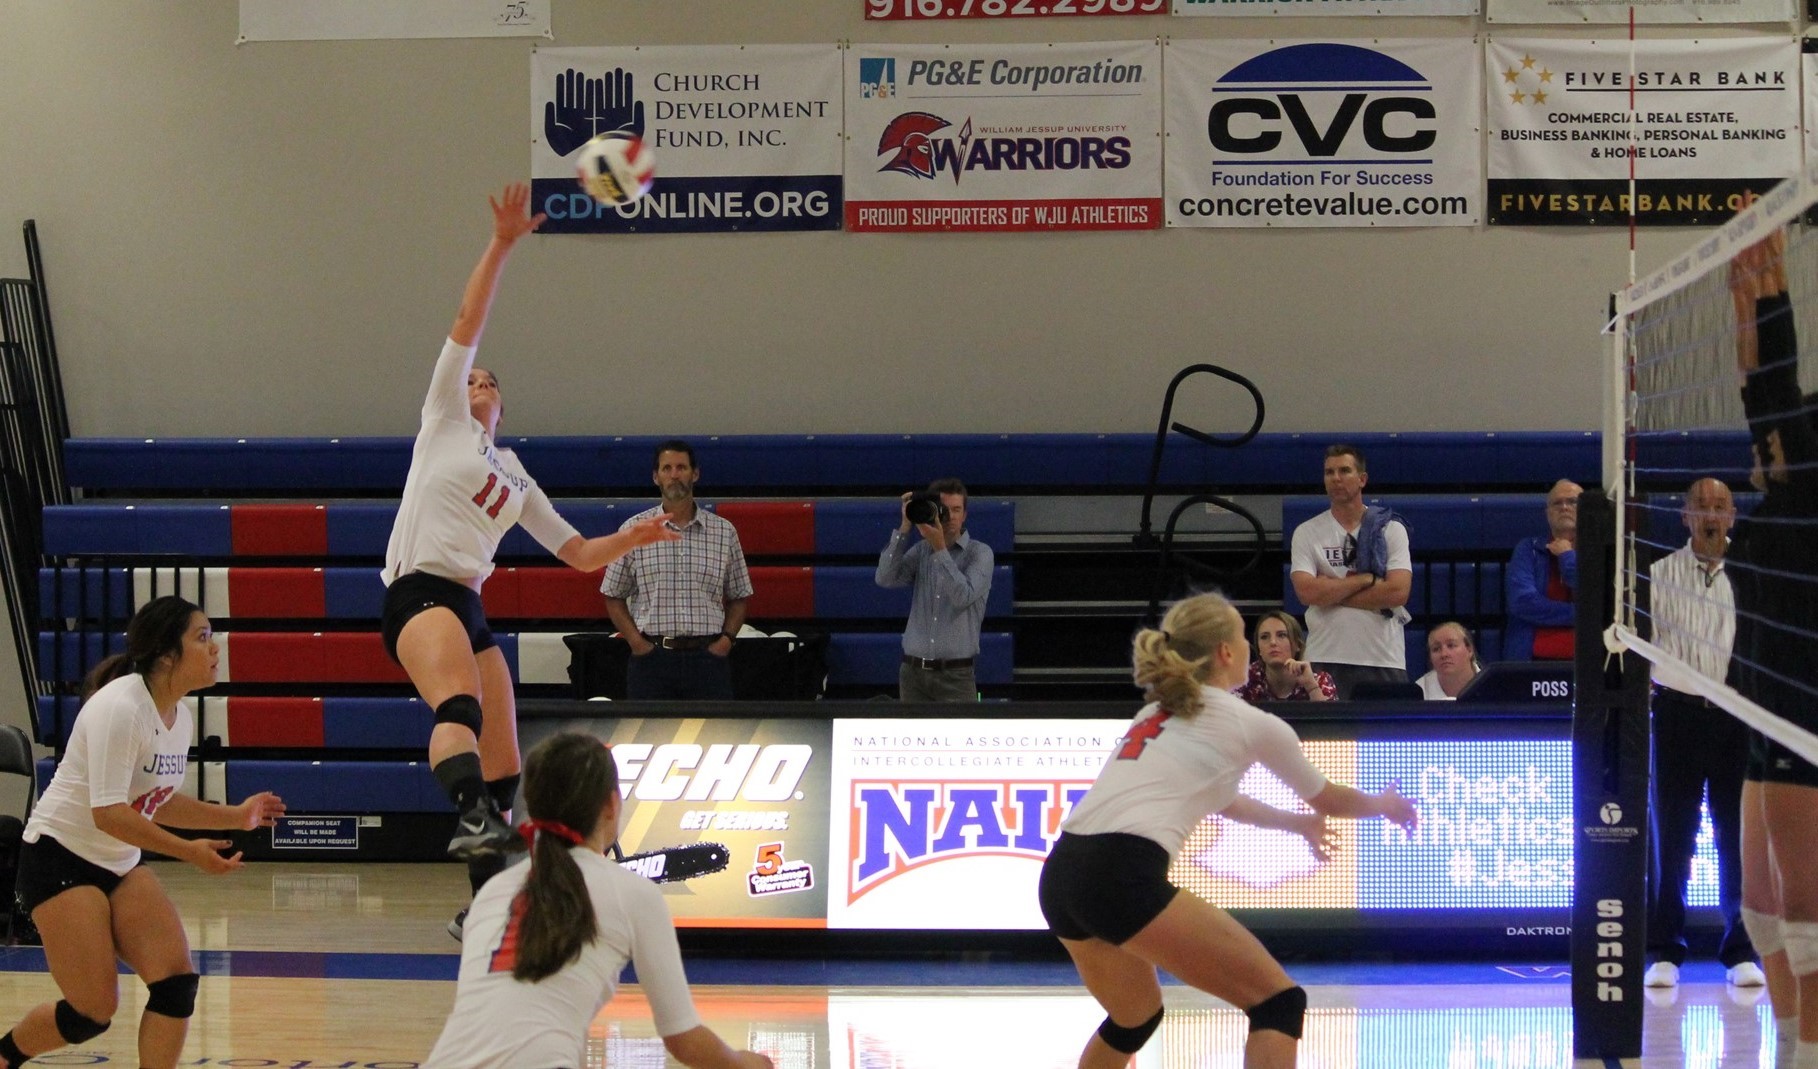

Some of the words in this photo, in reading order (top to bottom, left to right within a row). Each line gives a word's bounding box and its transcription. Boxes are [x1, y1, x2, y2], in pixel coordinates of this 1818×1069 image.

[907, 59, 984, 86] PG&E
[990, 58, 1143, 91] Corporation
[1566, 72, 1622, 86] FIVE
[1638, 72, 1701, 86] STAR
[1718, 71, 1785, 85] BANK
[1208, 93, 1437, 157] CVC
[1647, 112, 1682, 124] REAL
[1686, 112, 1739, 125] ESTATE,
[738, 129, 787, 147] INC.
[1025, 125, 1064, 133] JESSUP
[1066, 125, 1127, 133] UNIVERSITY
[1501, 129, 1567, 141] BUSINESS
[1644, 129, 1720, 141] PERSONAL
[1723, 129, 1786, 141] BANKING
[932, 133, 1131, 176] WARRIORS
[1591, 147, 1601, 158] &
[1604, 147, 1647, 158] HOME
[1651, 147, 1697, 158] LOANS
[1212, 171, 1314, 187] Foundation
[1321, 171, 1351, 185] For
[1356, 170, 1433, 186] Success
[1179, 192, 1467, 216] concretevalue.com
[859, 208, 907, 226] PROUD
[912, 207, 1007, 226] SUPPORTERS
[1012, 207, 1030, 225] OF
[1035, 206, 1067, 225] WJU
[1071, 205, 1149, 224] ATHLETICS
[472, 472, 511, 520] 11
[1532, 681, 1569, 697] POSS
[853, 736, 951, 747] NATIONAL
[965, 736, 1101, 747] ASSOCIATION
[853, 756, 1025, 766] INTERCOLLEGIATE
[1420, 765, 1552, 804] Check
[680, 810, 716, 830] GET
[756, 843, 783, 877] 5
